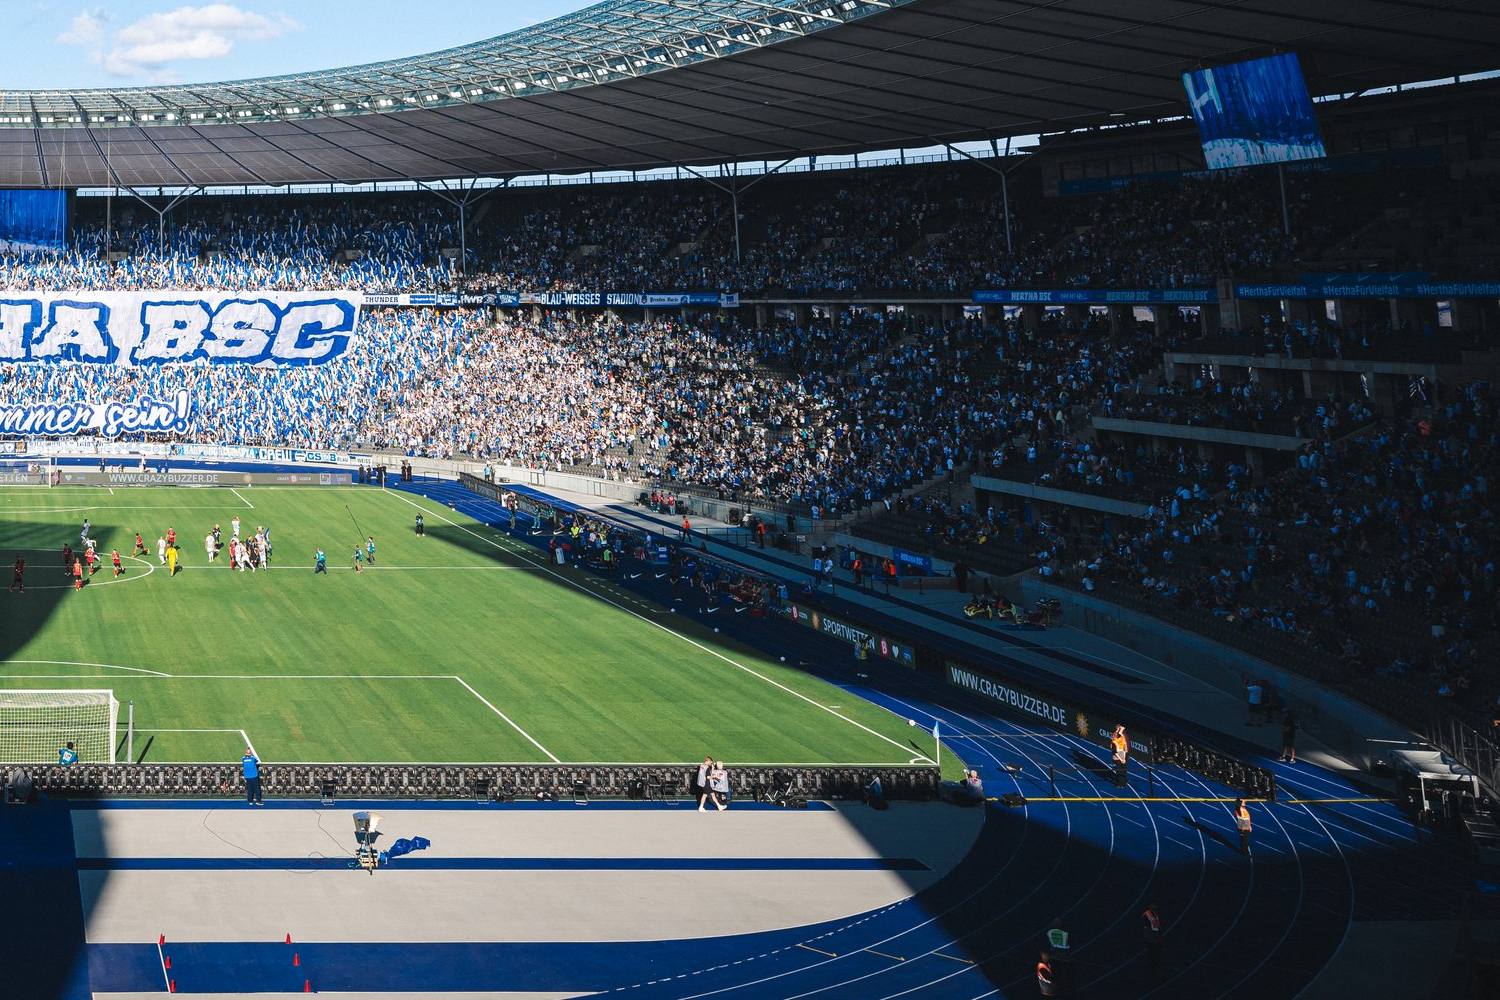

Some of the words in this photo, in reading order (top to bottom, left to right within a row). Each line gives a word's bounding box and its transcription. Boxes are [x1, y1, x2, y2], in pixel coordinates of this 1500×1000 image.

[541, 293, 600, 305] BLAU-WEISSES
[606, 293, 639, 305] STADION
[1011, 292, 1037, 301] HERTHA
[1039, 292, 1051, 301] BSC
[1106, 291, 1134, 301] HERTHA
[137, 298, 356, 365] BSC
[105, 389, 190, 434] sein!
[109, 474, 219, 483] WWW.CRAZYBUZZER.DE
[951, 667, 1067, 726] WWW.CRAZYBUZZER.DE
